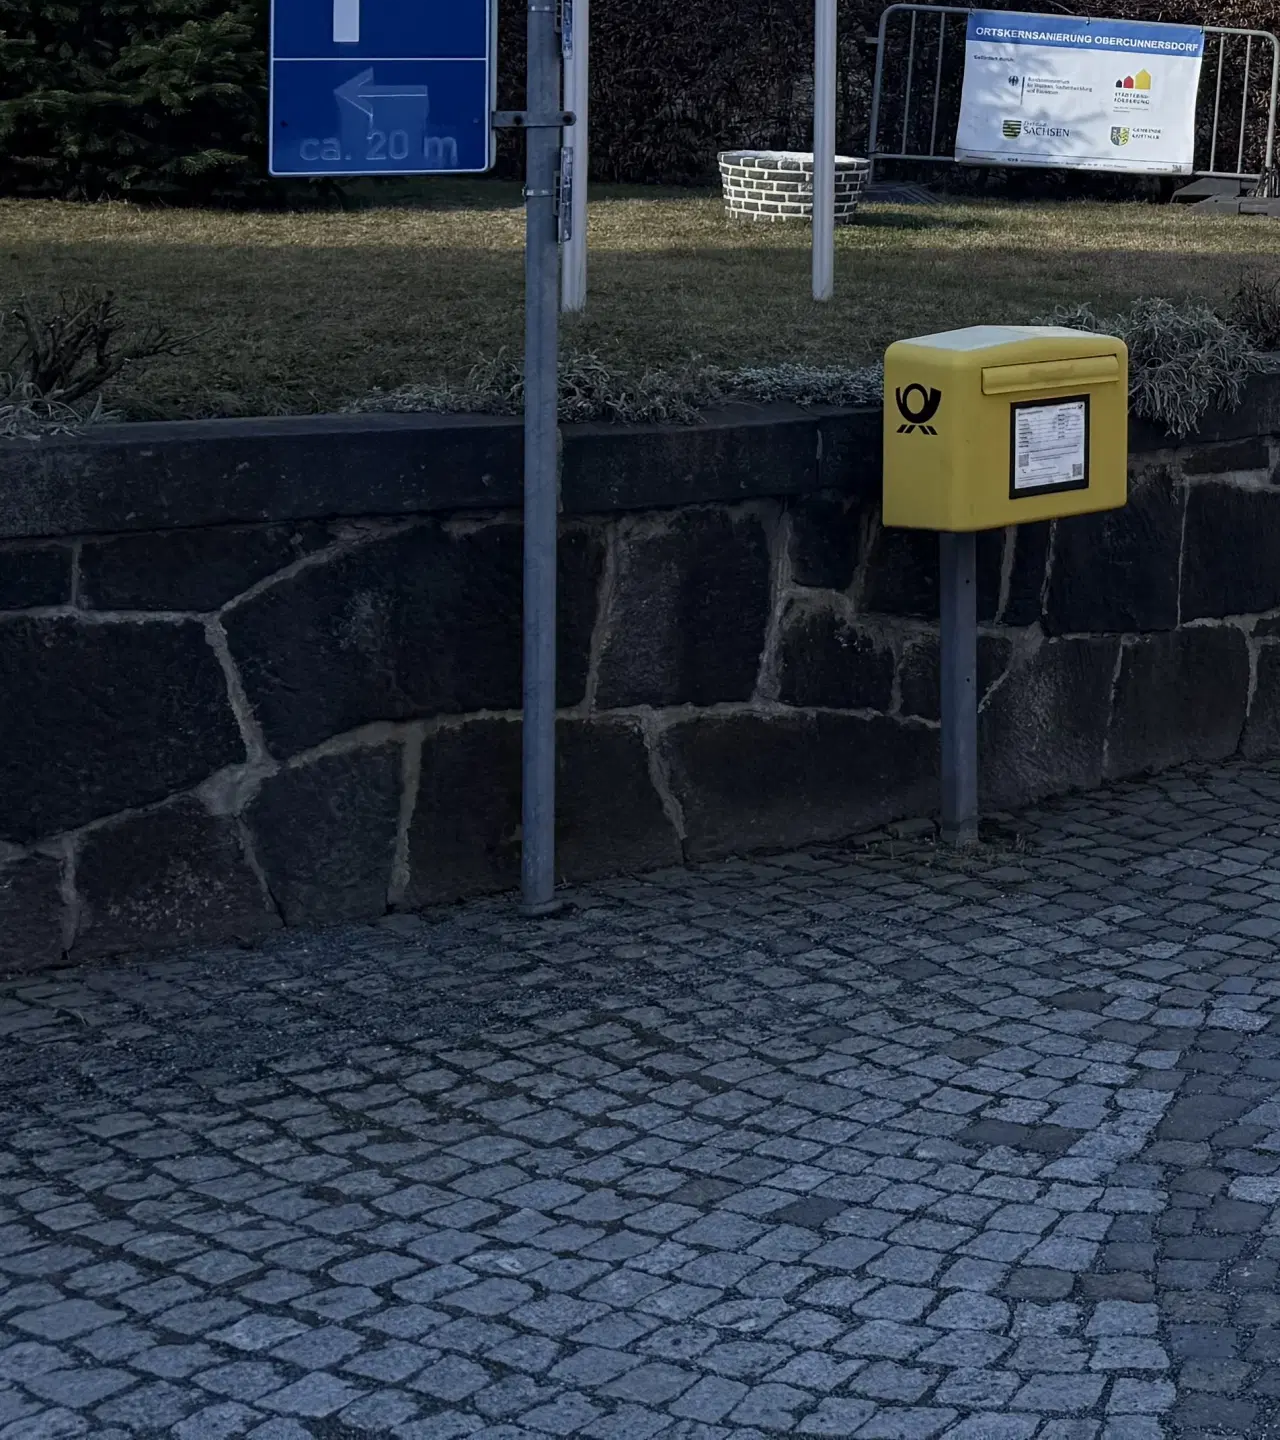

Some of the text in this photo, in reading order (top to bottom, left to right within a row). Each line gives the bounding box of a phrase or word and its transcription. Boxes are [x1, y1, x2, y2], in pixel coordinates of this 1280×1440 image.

[975, 26, 1199, 53] ORTSKERNSANIERUNG OBERCUNNERSDORF
[1023, 125, 1070, 137] SACHSEN
[300, 129, 458, 164] ca. 20 m
